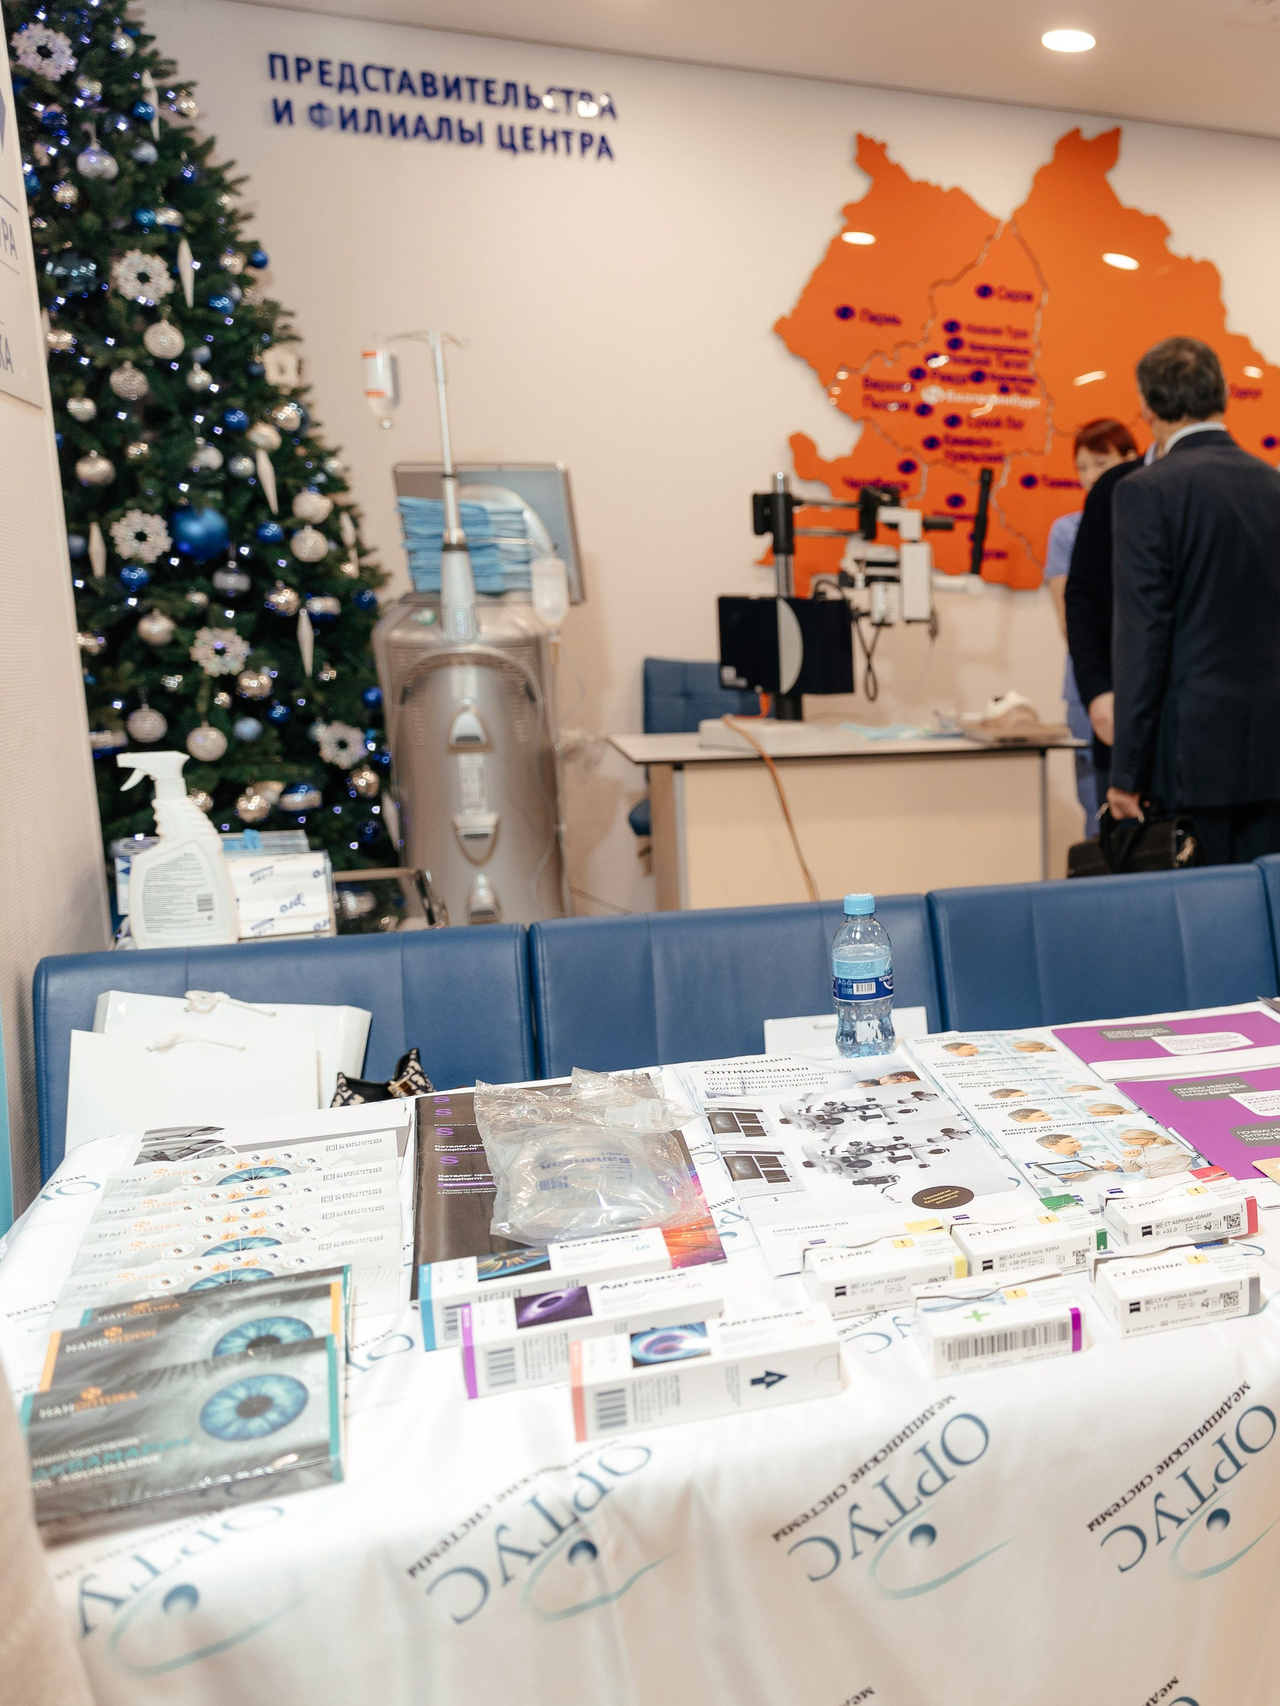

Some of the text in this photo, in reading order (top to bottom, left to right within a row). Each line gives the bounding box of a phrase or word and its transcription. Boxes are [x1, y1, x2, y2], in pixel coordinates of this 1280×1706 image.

[272, 98, 615, 160] И ФИЛИАЛЫ ЦЕНТРА
[704, 1066, 809, 1075] Оптимизация
[839, 1248, 872, 1260] LARA
[986, 1225, 1016, 1235] LARA
[1130, 1262, 1183, 1275] ASPHINA
[772, 1395, 957, 1543] медицинские системы
[787, 1412, 990, 1583] ОРТУС
[1086, 1381, 1252, 1534] медицинские системы
[1100, 1404, 1277, 1573] ОРТУС
[78, 1505, 285, 1639] ОРТУ
[406, 1503, 491, 1580] системы
[426, 1445, 653, 1625] ОРТУС
